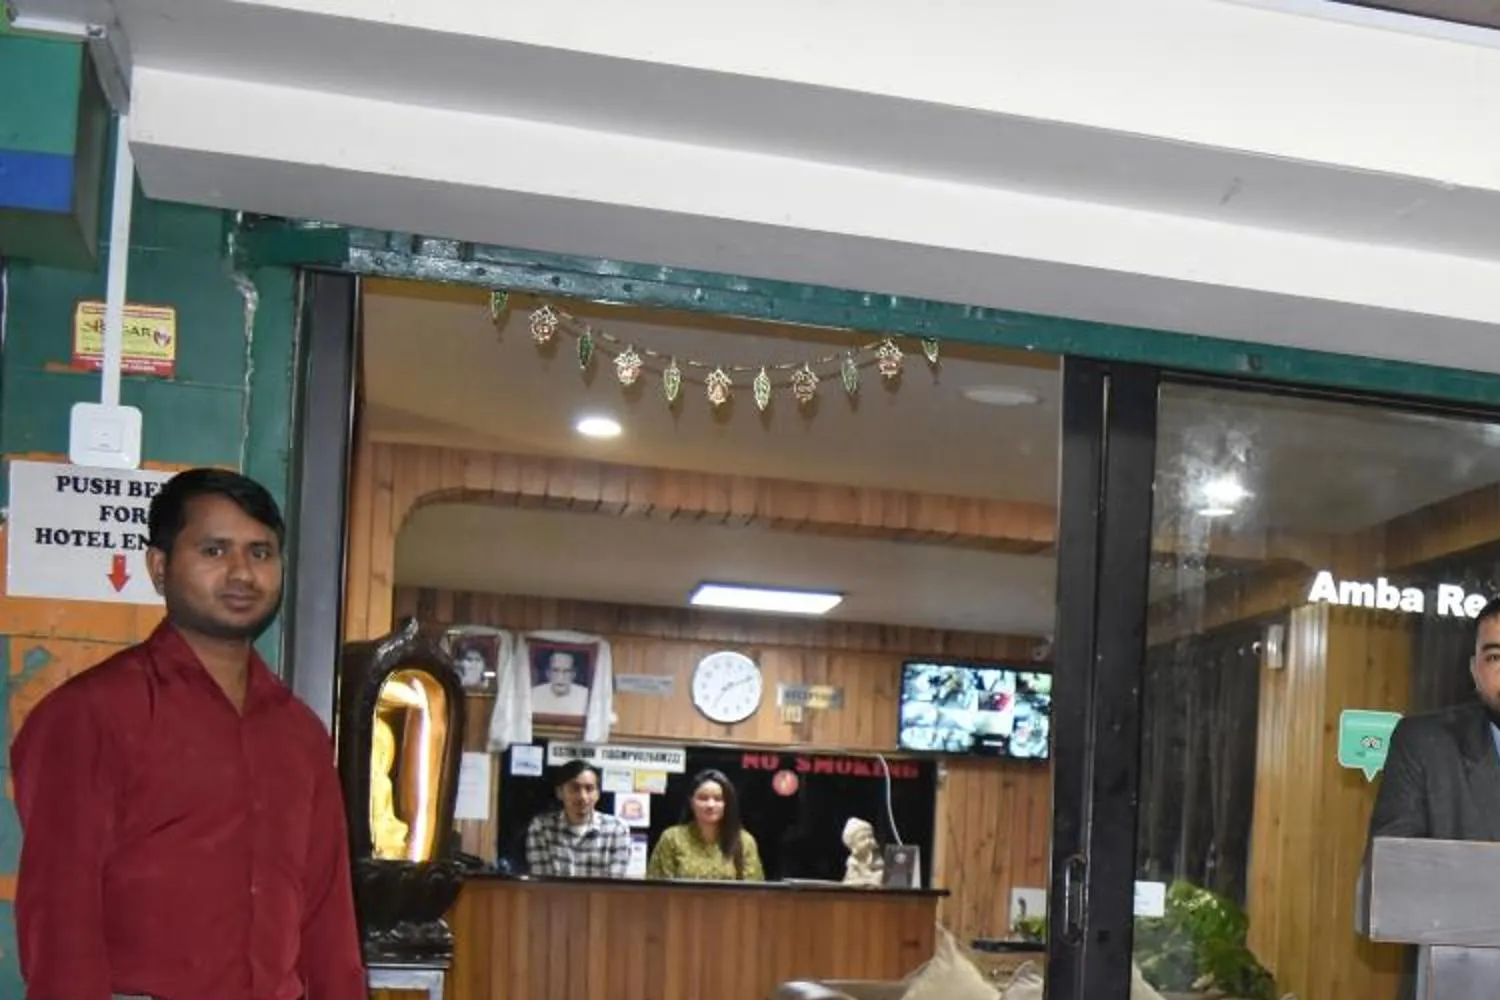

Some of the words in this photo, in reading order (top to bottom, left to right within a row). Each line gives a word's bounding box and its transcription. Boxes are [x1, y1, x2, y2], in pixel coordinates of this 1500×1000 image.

[55, 475, 121, 496] PUSH
[99, 505, 149, 525] FOR
[35, 527, 116, 549] HOTEL
[1307, 570, 1424, 613] Amba
